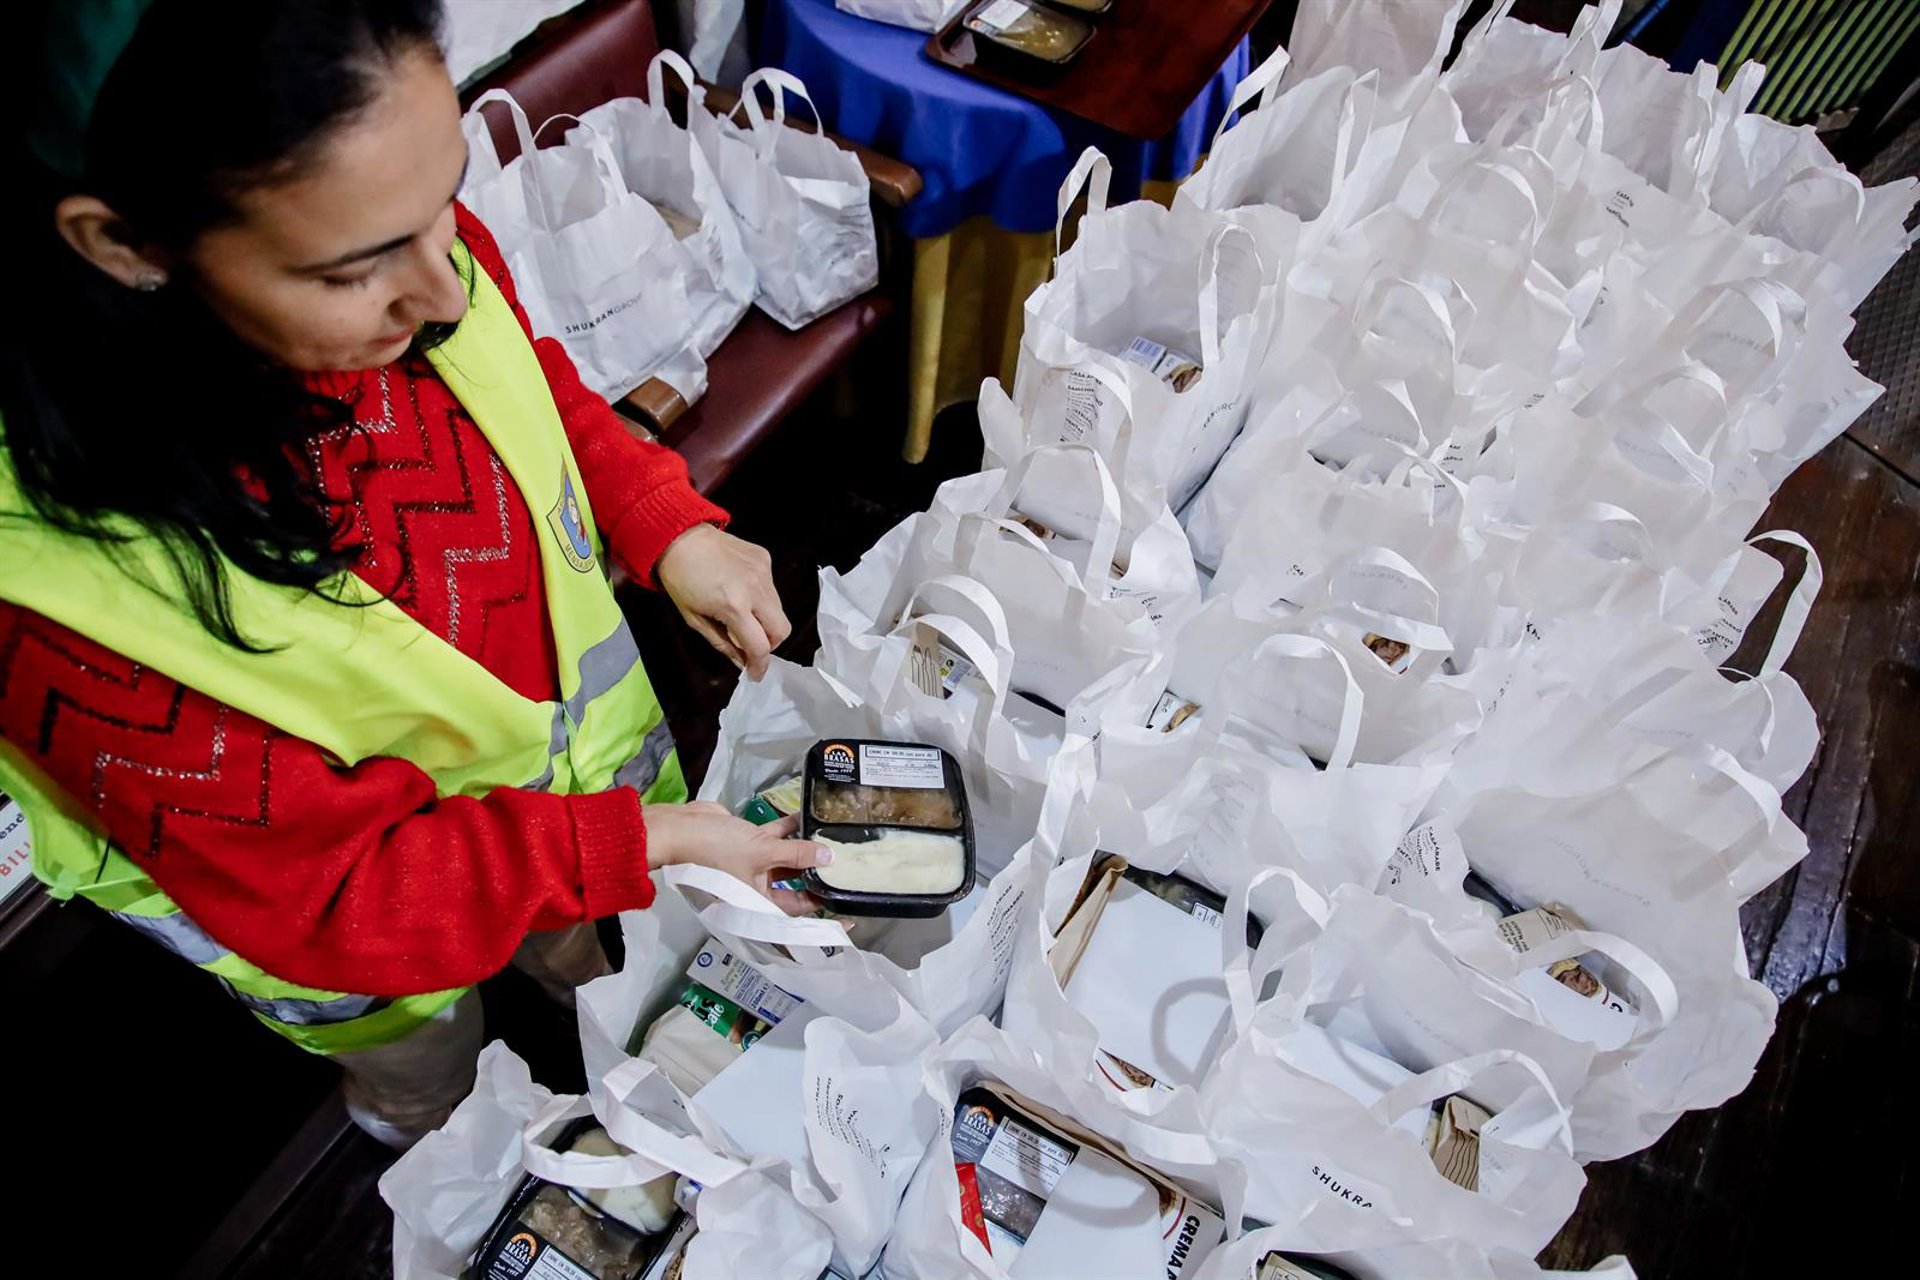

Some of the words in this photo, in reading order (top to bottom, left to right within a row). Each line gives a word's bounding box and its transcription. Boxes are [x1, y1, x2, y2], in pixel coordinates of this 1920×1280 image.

[963, 1114, 992, 1135] BRASAS
[504, 1241, 533, 1265] BRASAS
[516, 1240, 530, 1253] LAS
[1167, 1215, 1201, 1271] CREMA
